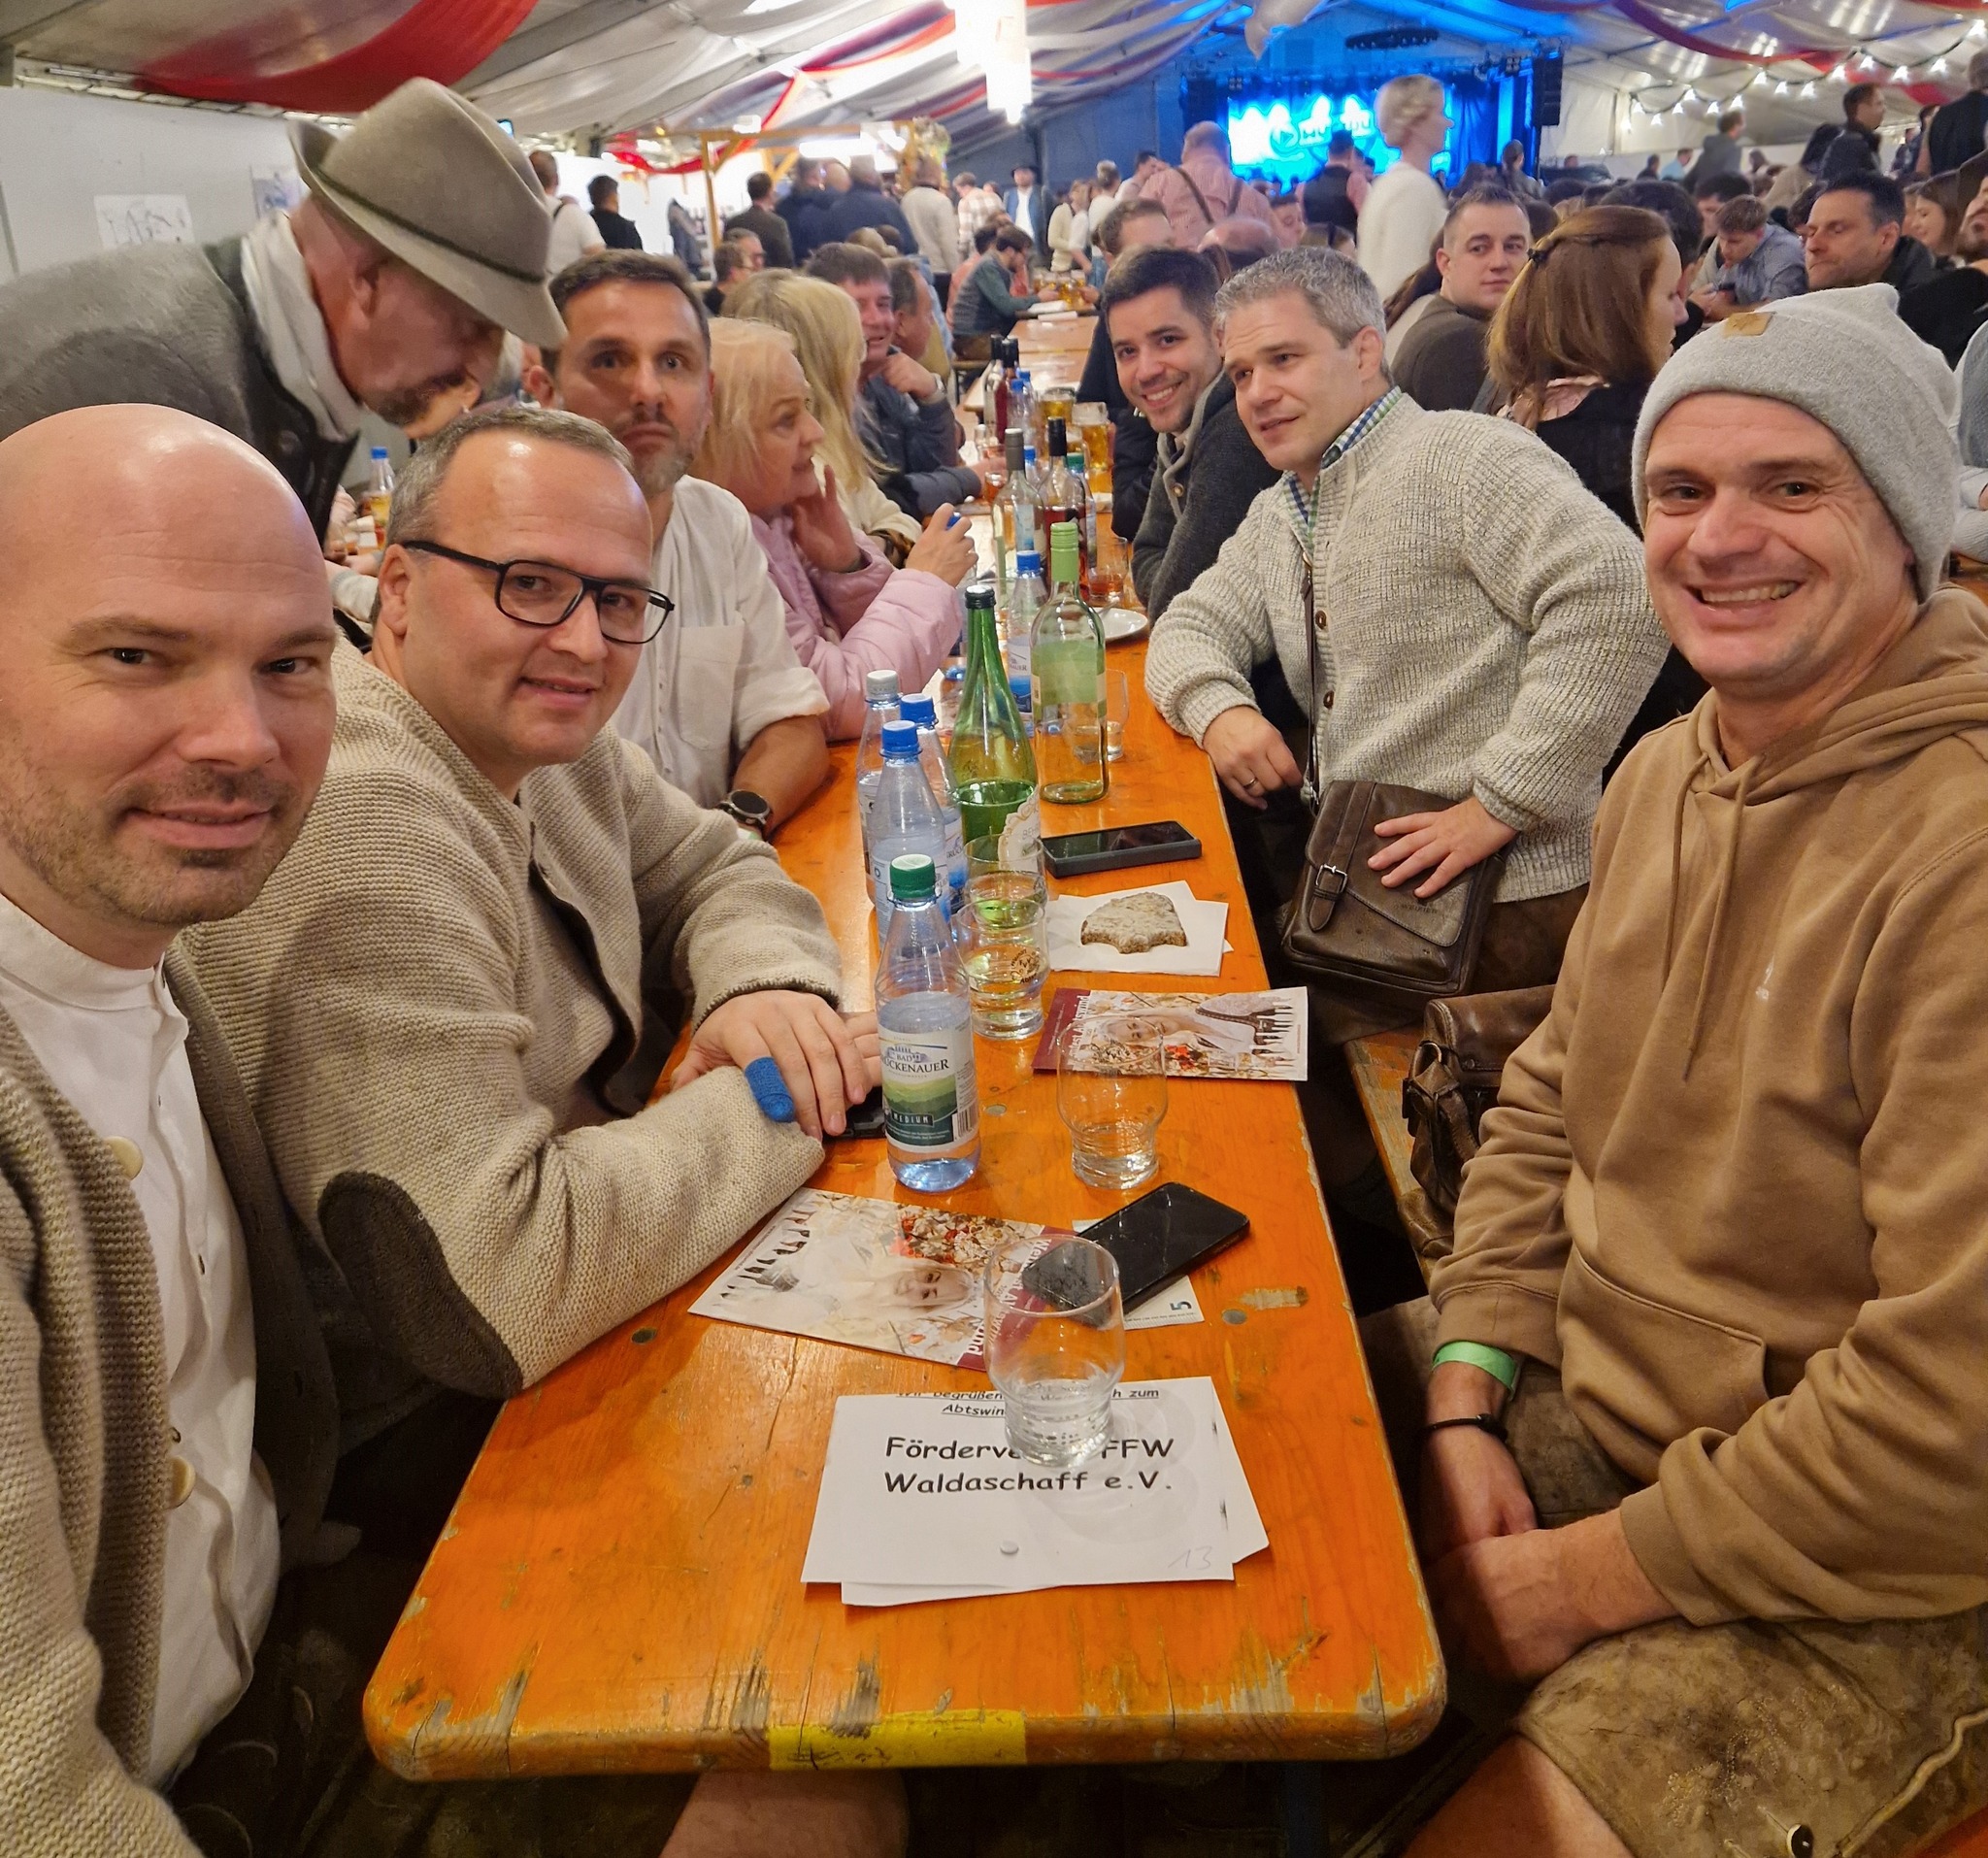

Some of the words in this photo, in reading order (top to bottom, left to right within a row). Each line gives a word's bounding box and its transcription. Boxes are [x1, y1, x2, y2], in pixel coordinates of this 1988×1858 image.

[881, 1056, 949, 1073] ÜCKENAUER
[893, 1112, 929, 1124] MEDIUM
[1129, 1389, 1159, 1398] zum
[942, 1404, 1005, 1415] Abtswin
[885, 1436, 1021, 1460] Förderve
[1102, 1438, 1175, 1459] FFW
[884, 1472, 1088, 1493] Waldaschaff
[1104, 1471, 1172, 1489] e.V.
